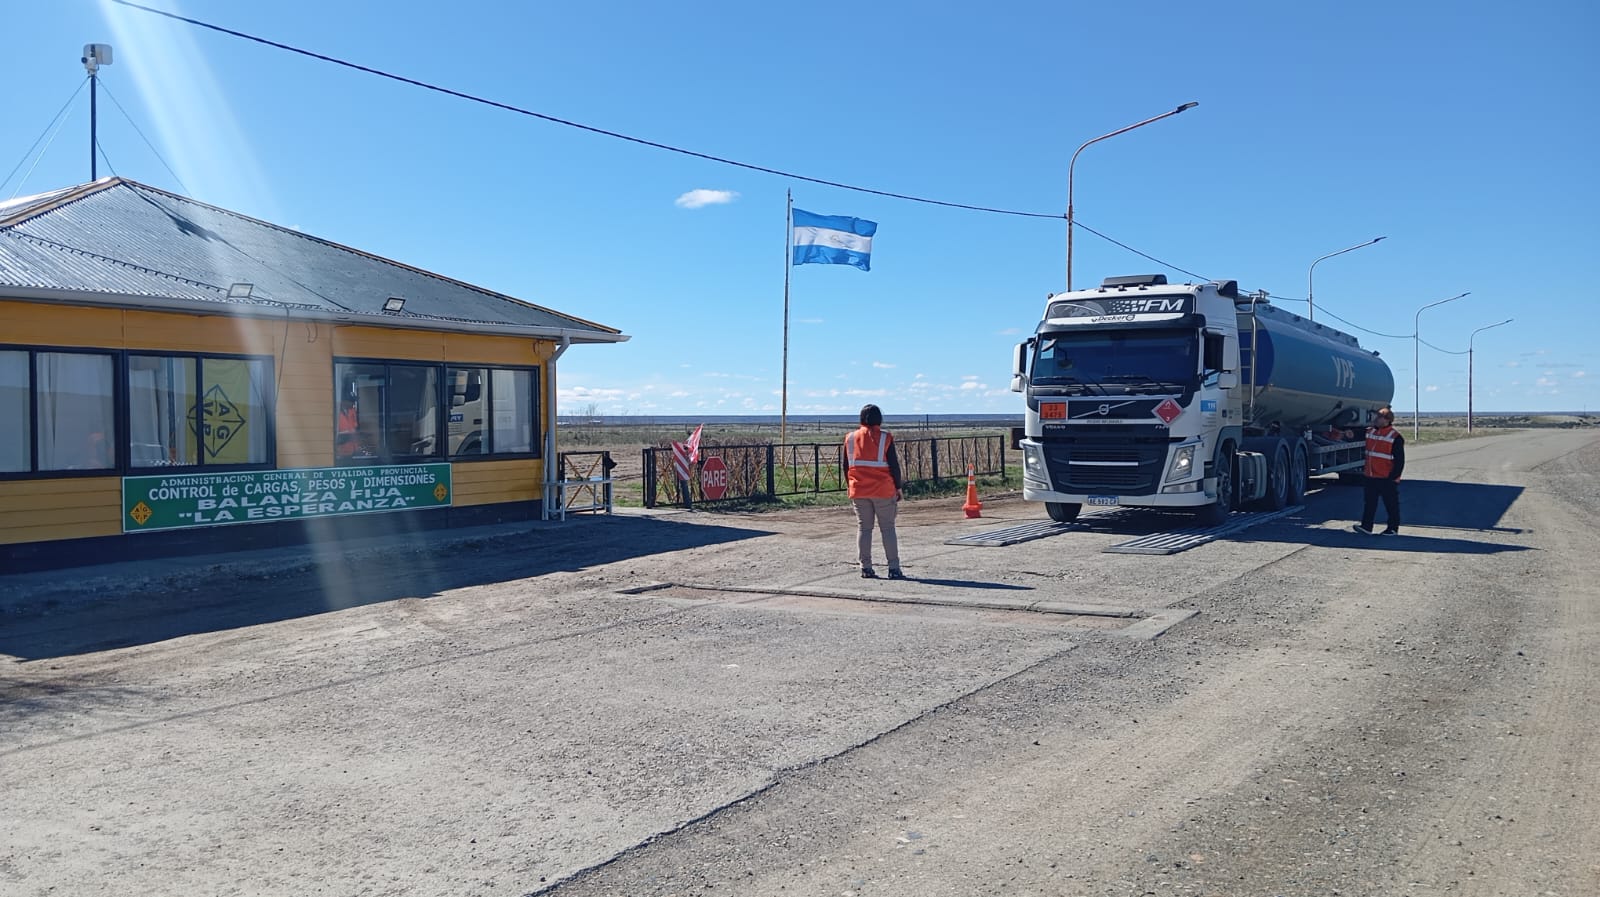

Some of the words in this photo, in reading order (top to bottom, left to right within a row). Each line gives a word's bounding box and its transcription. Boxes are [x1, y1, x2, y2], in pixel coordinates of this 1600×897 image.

[1144, 298, 1184, 312] FM
[1331, 355, 1355, 389] YPF
[148, 485, 217, 501] CONTROL
[222, 485, 239, 496] de
[244, 480, 302, 495] CARGAS,
[308, 478, 346, 491] PESOS
[350, 479, 357, 490] y
[363, 473, 436, 488] DIMENSIONES
[160, 474, 255, 487] ADMINISTRACION
[263, 472, 307, 482] GENERAL
[331, 470, 374, 478] VIALIDAD
[380, 467, 428, 476] PROVINCIAL
[703, 470, 726, 488] PARE
[197, 491, 338, 510] BALANZA
[350, 487, 402, 500] FIJA
[247, 496, 416, 518] ESPERANZA"
